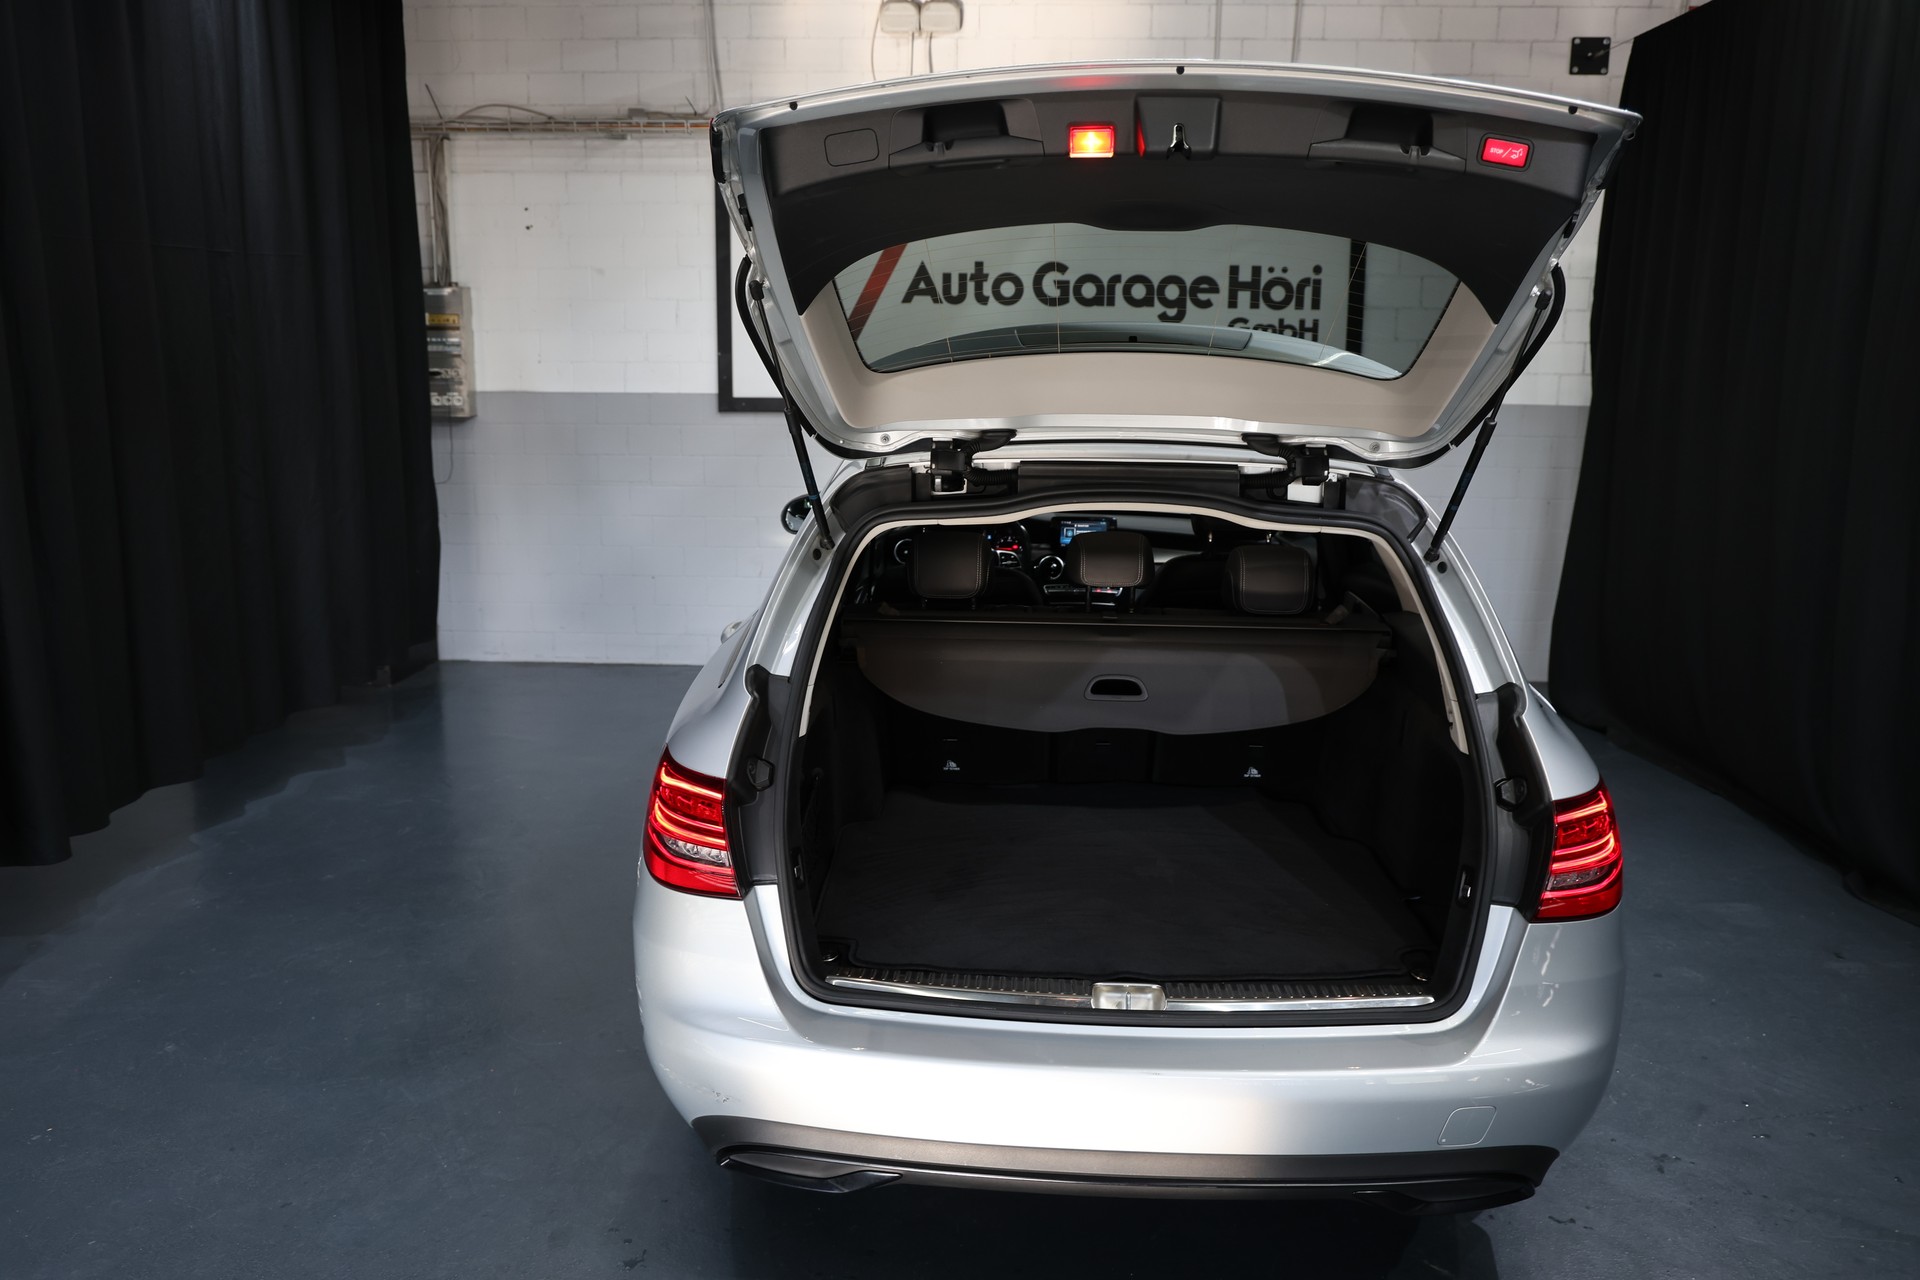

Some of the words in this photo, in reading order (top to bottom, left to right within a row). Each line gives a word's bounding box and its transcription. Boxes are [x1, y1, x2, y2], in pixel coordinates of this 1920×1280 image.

[901, 260, 1024, 306] Auto
[1032, 261, 1220, 323] Garage
[1227, 264, 1322, 311] Höri
